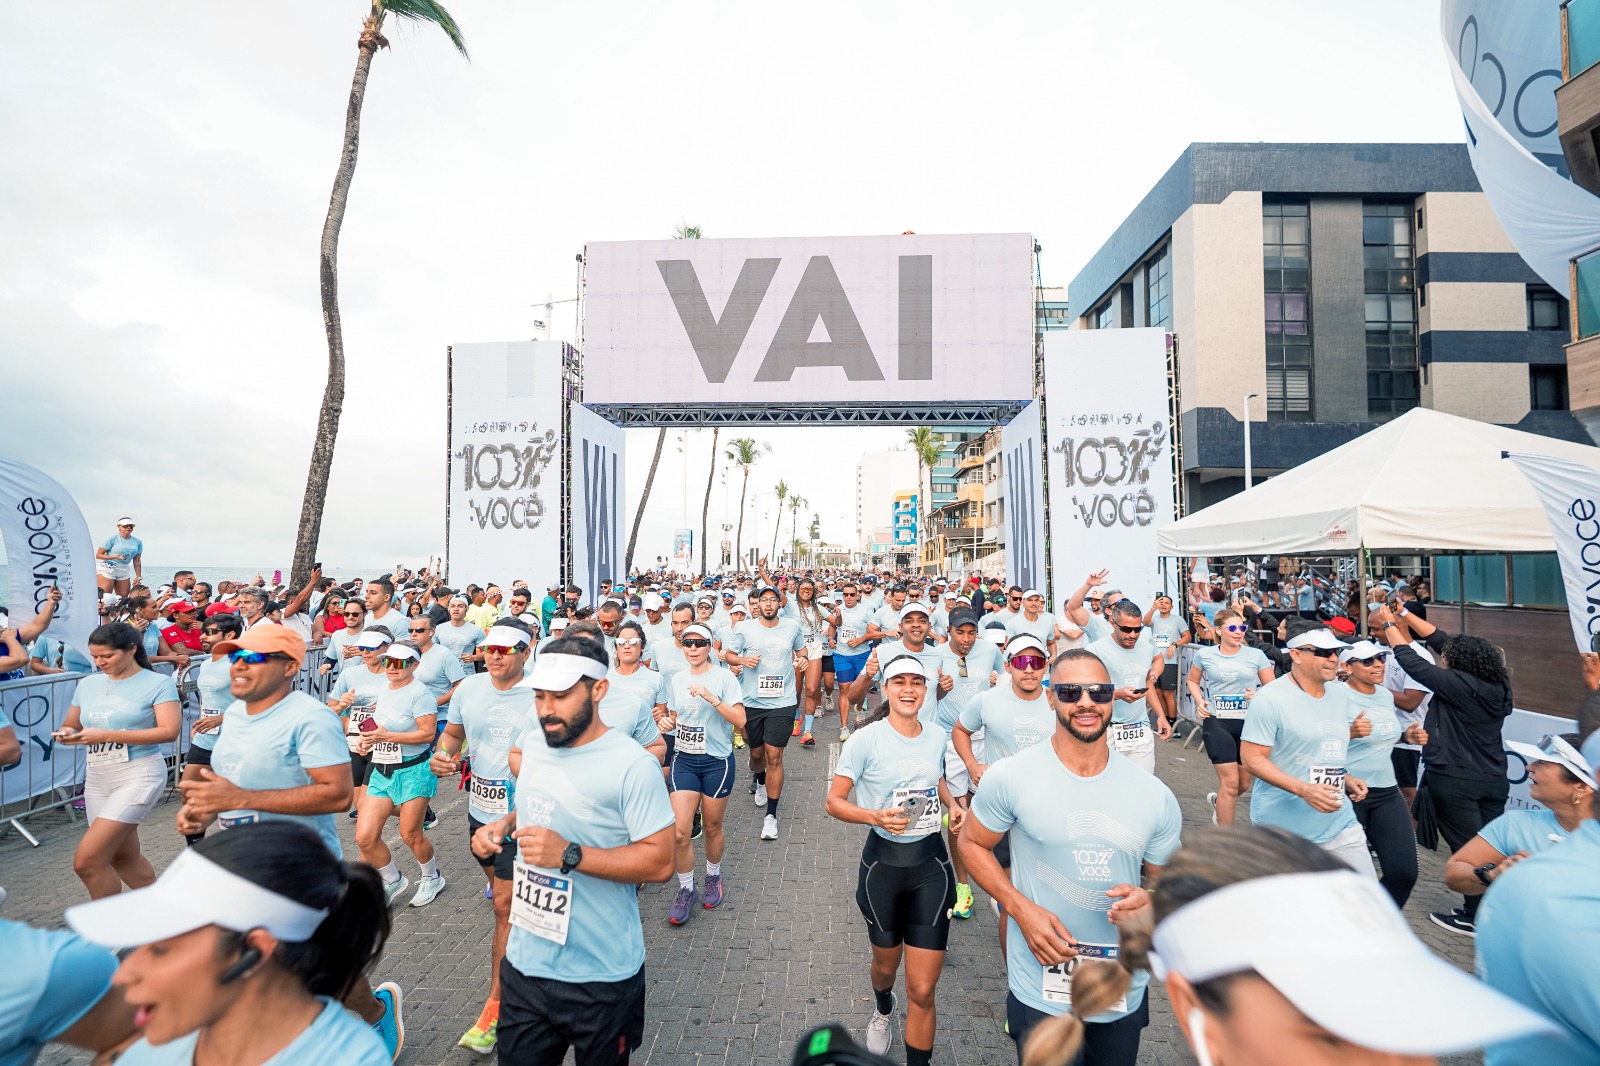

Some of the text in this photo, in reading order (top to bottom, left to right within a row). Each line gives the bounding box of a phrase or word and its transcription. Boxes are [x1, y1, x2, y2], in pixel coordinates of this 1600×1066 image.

[655, 254, 933, 384] VAI
[583, 438, 617, 605] VAI
[57, 516, 70, 560] NUTRITION
[66, 572, 75, 601] HEALTH
[759, 681, 783, 689] 11361
[676, 730, 705, 743] 10545
[1117, 729, 1144, 740] 10516
[374, 742, 399, 753] 10766
[471, 782, 506, 800] 10308
[1072, 847, 1116, 865] 100%
[1079, 865, 1111, 877] você
[515, 880, 568, 916] 11112
